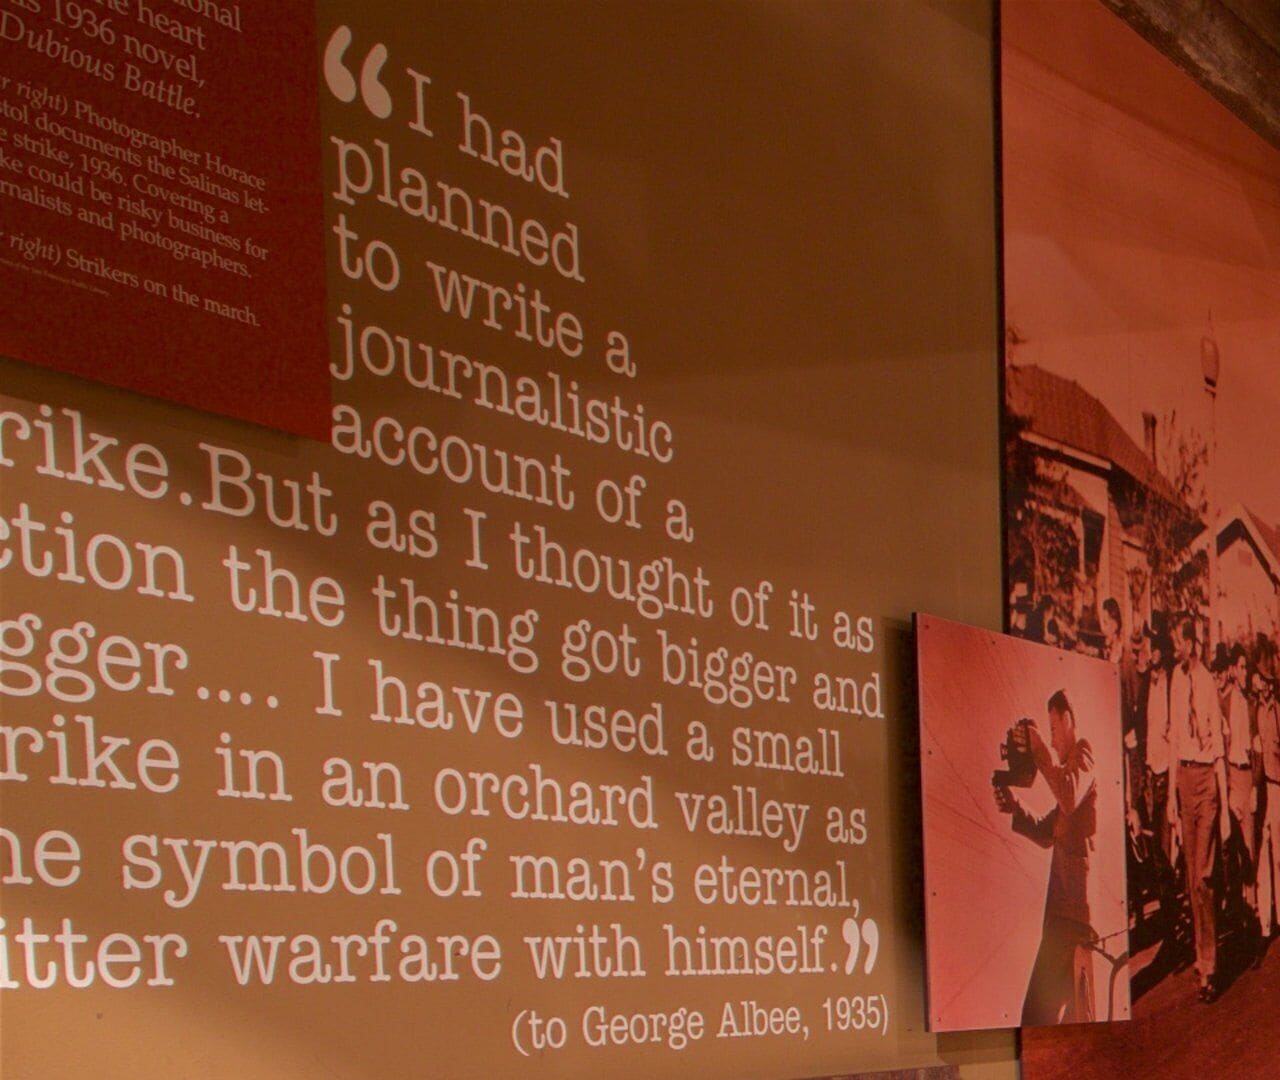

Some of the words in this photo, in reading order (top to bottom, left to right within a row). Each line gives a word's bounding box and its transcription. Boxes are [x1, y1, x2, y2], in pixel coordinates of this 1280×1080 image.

[0, 9, 116, 82] Dubious
[123, 62, 201, 120] Battle.
[51, 0, 117, 46] 1936
[122, 34, 207, 89] novel,
[12, 133, 75, 170] strike,
[79, 153, 128, 188] 1936.
[132, 173, 216, 225] Covering
[34, 112, 143, 168] documents
[74, 99, 202, 166] Photographer
[204, 152, 267, 192] Horace
[456, 91, 570, 199] had
[117, 196, 164, 229] risky
[330, 135, 586, 284] planned
[66, 248, 140, 289] Strikers
[332, 213, 401, 292] to
[425, 261, 584, 358] write
[605, 330, 637, 378] a
[329, 310, 674, 464] journalistic
[331, 404, 575, 511] account
[595, 474, 647, 530] of
[665, 499, 694, 543] a
[366, 500, 439, 559] as
[463, 507, 489, 571] I
[509, 521, 714, 643] thought
[730, 580, 774, 631] of
[788, 589, 819, 641] it
[833, 611, 875, 654] as
[222, 545, 346, 628] the
[371, 574, 540, 674] thing
[561, 619, 641, 683] got
[656, 629, 798, 709] bigger
[813, 672, 886, 719] and
[312, 650, 343, 717] I
[367, 658, 524, 739] have
[544, 700, 669, 757] used
[686, 720, 715, 762] a
[732, 727, 845, 778] small
[214, 732, 294, 802] in
[321, 757, 411, 811] an
[434, 763, 659, 829] orchard
[674, 785, 811, 853] valley
[826, 806, 868, 845] as
[122, 827, 402, 909] symbol
[426, 837, 488, 898] of
[509, 847, 675, 904] man’s
[694, 835, 861, 918] eternal,
[218, 918, 502, 986] warfare
[523, 923, 647, 980] with
[512, 1009, 568, 1057] (to
[582, 1006, 705, 1050] George
[716, 1000, 810, 1041] Albee,
[822, 994, 889, 1036] 1935)
